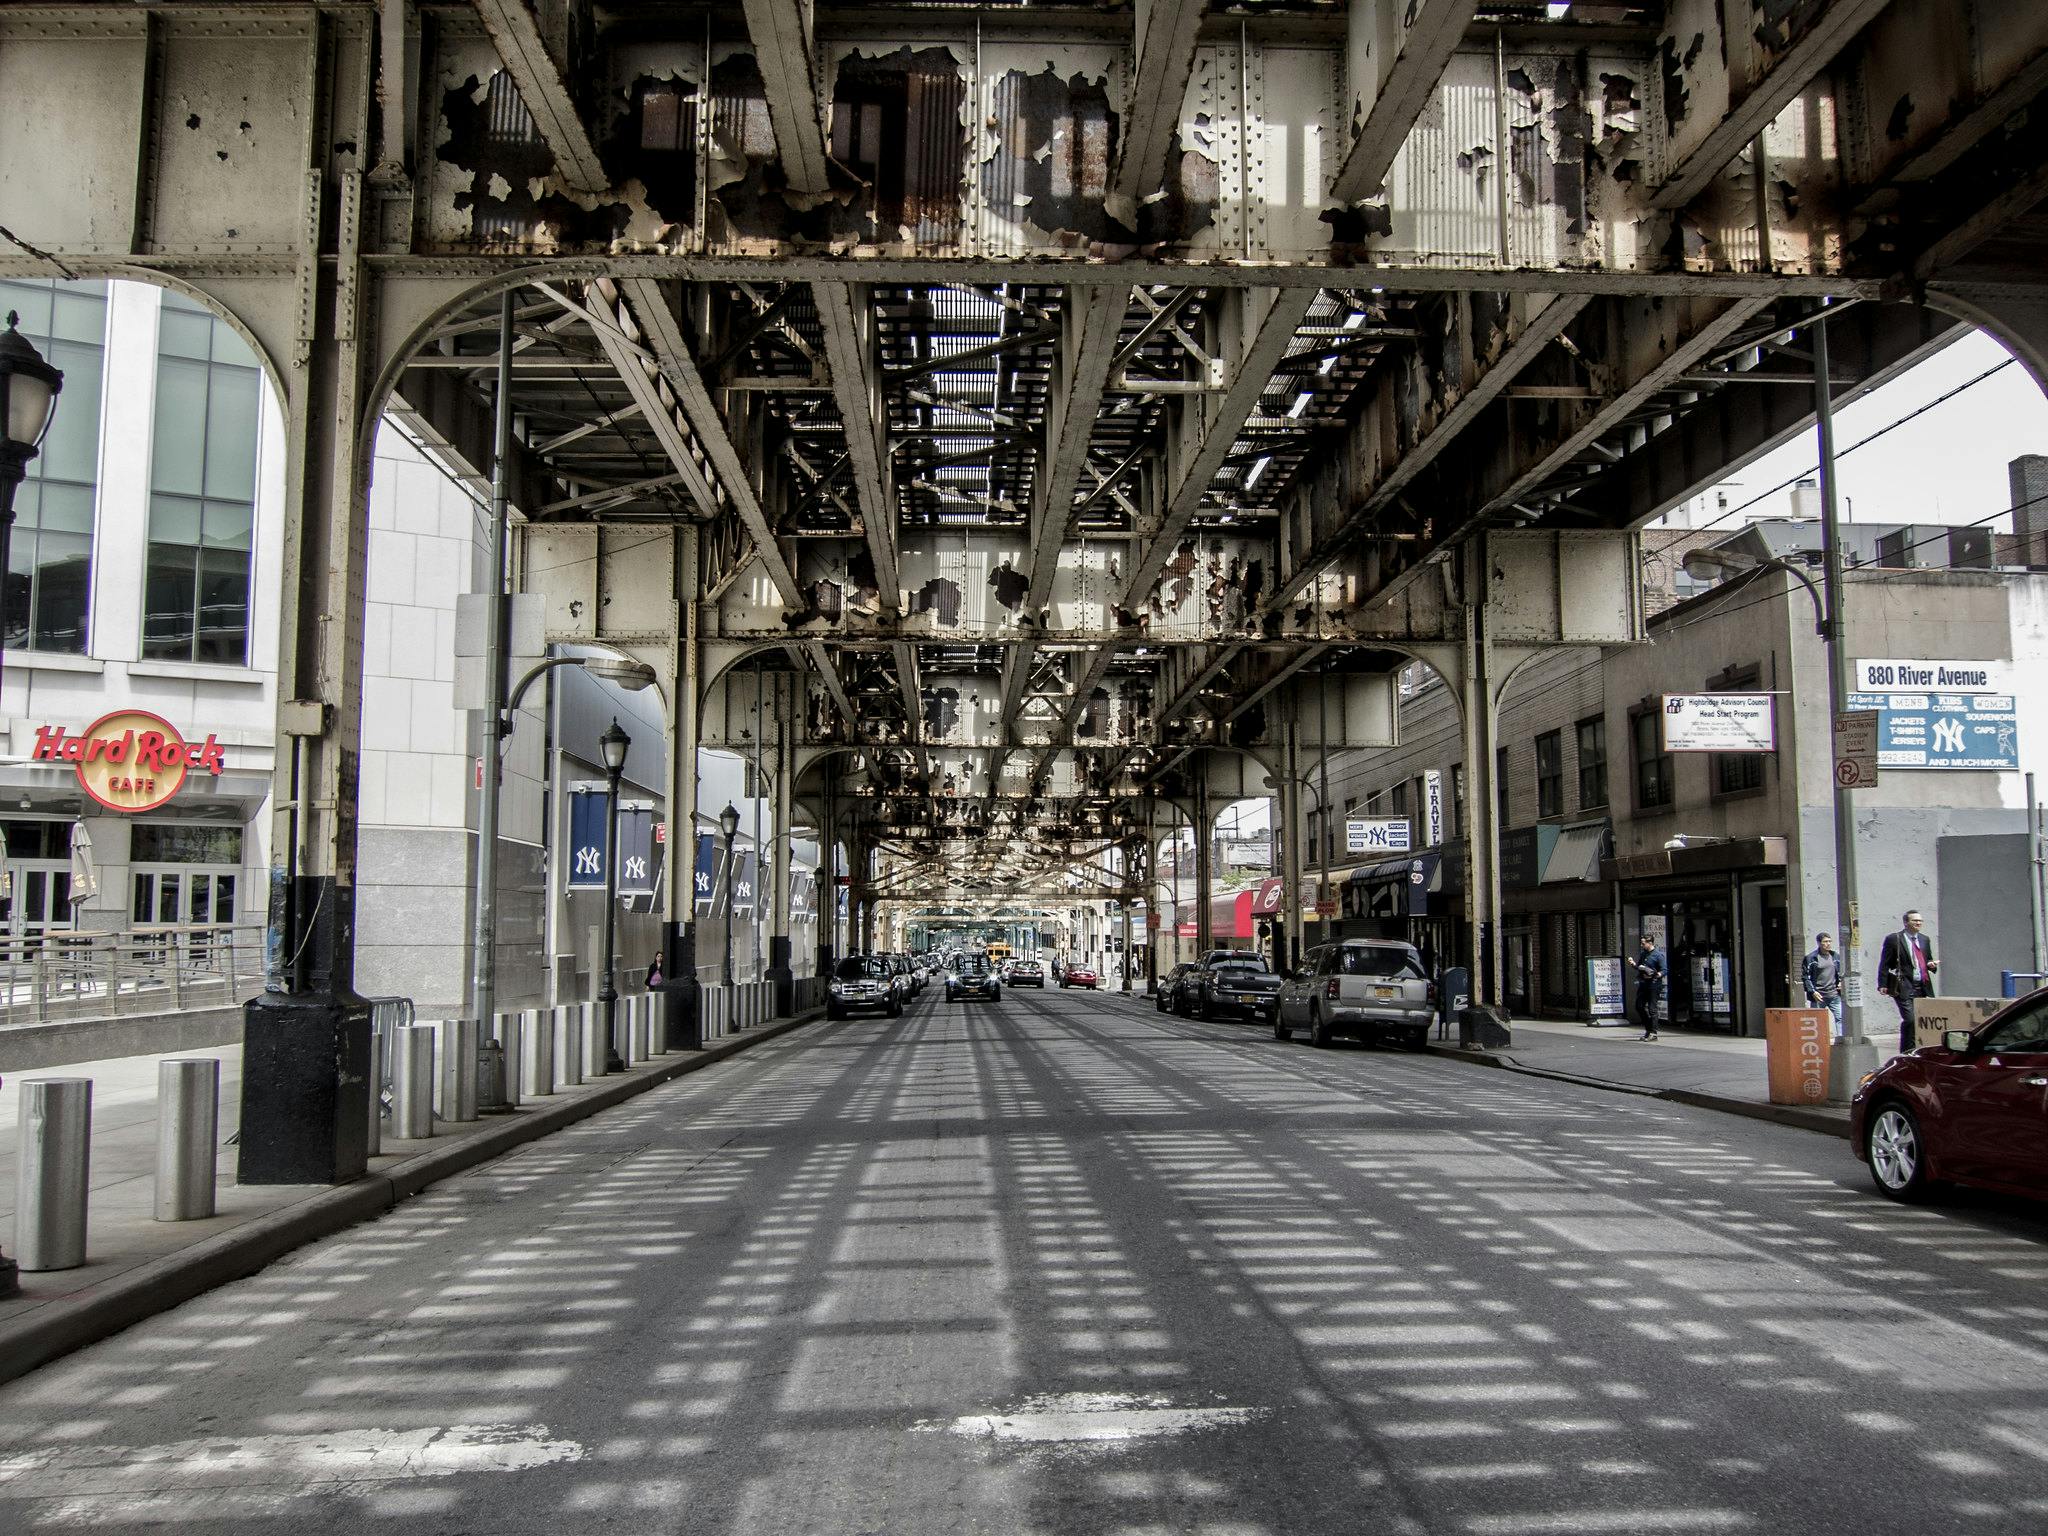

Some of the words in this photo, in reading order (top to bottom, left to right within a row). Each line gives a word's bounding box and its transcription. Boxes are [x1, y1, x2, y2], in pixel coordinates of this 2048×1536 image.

[1868, 666, 1893, 685] 880
[1898, 666, 1933, 685] River
[1937, 666, 1987, 685] Avenue
[1689, 698, 1719, 707] Highbridge
[1721, 698, 1746, 707] Advisory
[1747, 698, 1769, 706] Council
[1700, 710, 1715, 718] Head
[1716, 710, 1732, 718] Start
[1734, 711, 1759, 719] Program
[1848, 721, 1875, 729] PARKING
[1889, 727, 1925, 735] T-SHIRTS
[32, 725, 134, 764] Hard
[136, 730, 225, 775] Rock
[1952, 759, 1980, 767] MUCH
[108, 777, 155, 793] CAFE
[1429, 785, 1440, 845] TRAVEL
[1919, 1016, 1949, 1031] NYCT
